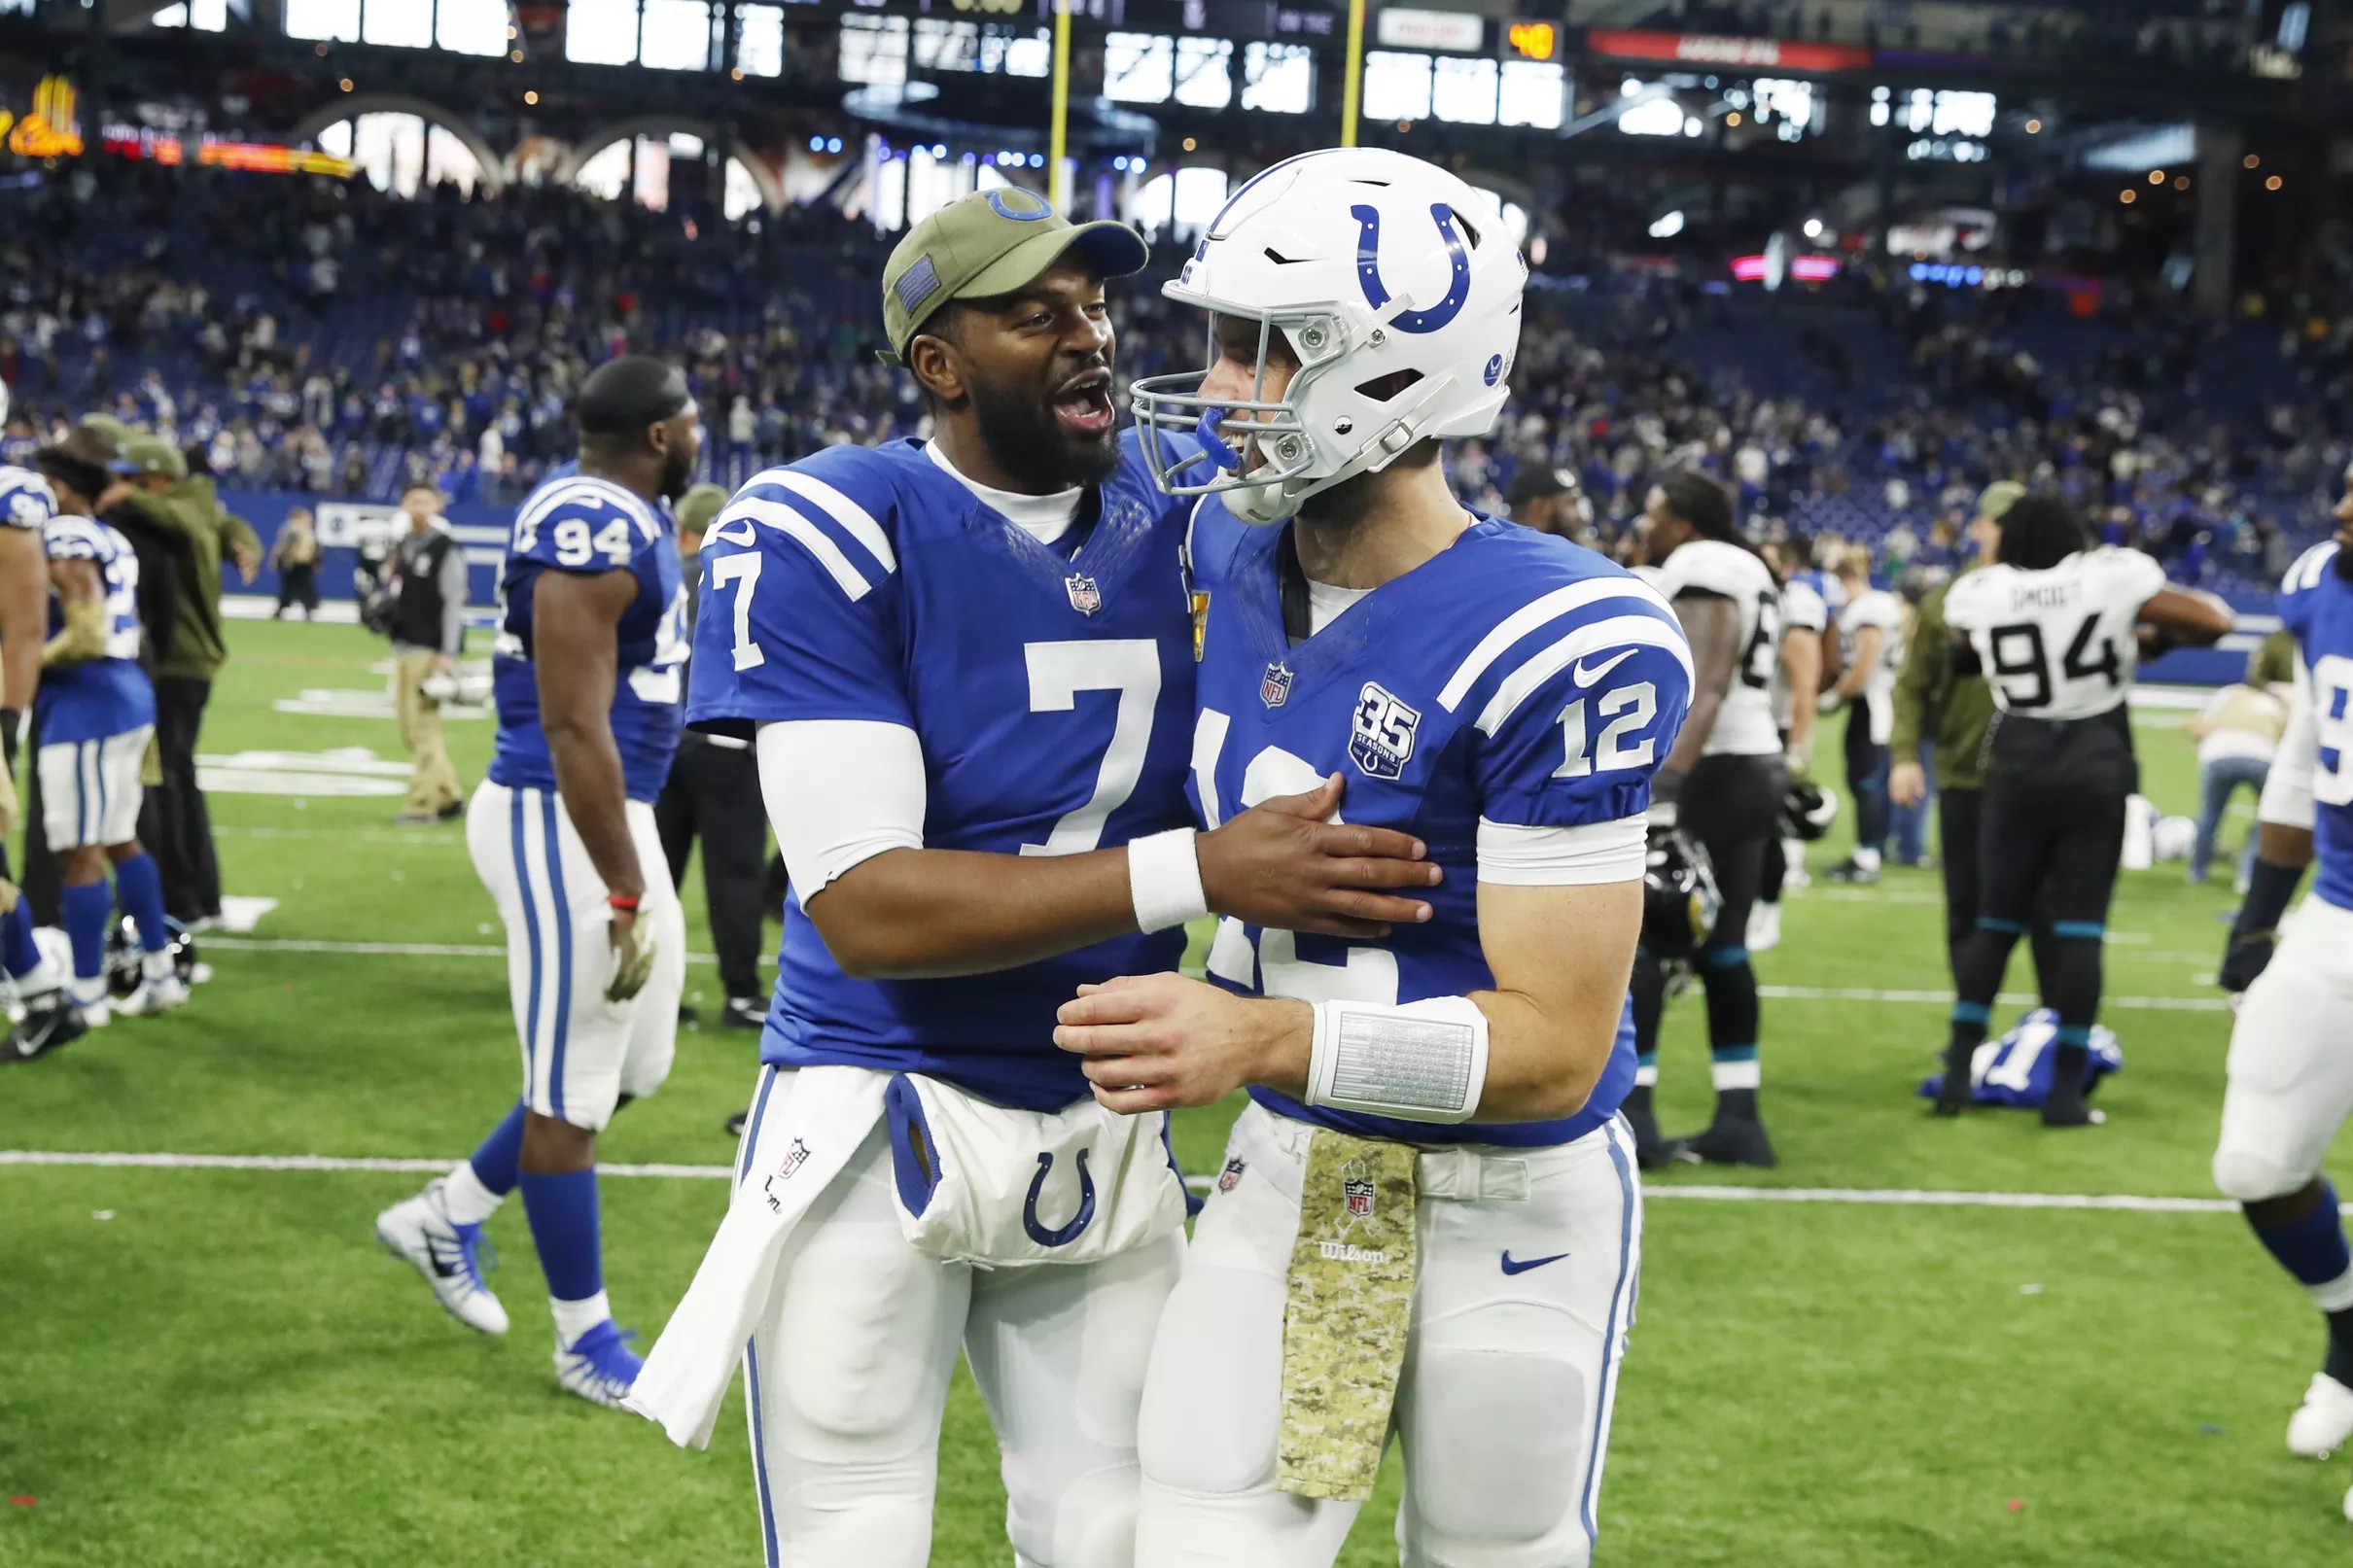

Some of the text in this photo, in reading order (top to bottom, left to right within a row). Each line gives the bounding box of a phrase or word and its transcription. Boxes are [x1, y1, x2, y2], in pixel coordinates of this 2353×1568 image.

[553, 517, 631, 566] 94
[713, 550, 765, 672] 7
[1990, 611, 2119, 708] 94
[1019, 638, 1162, 857] 7
[1354, 685, 1418, 759] 35
[1356, 733, 1396, 763] SEASONS
[1551, 681, 1658, 779] 12
[1318, 1240, 1385, 1264] Wilson
